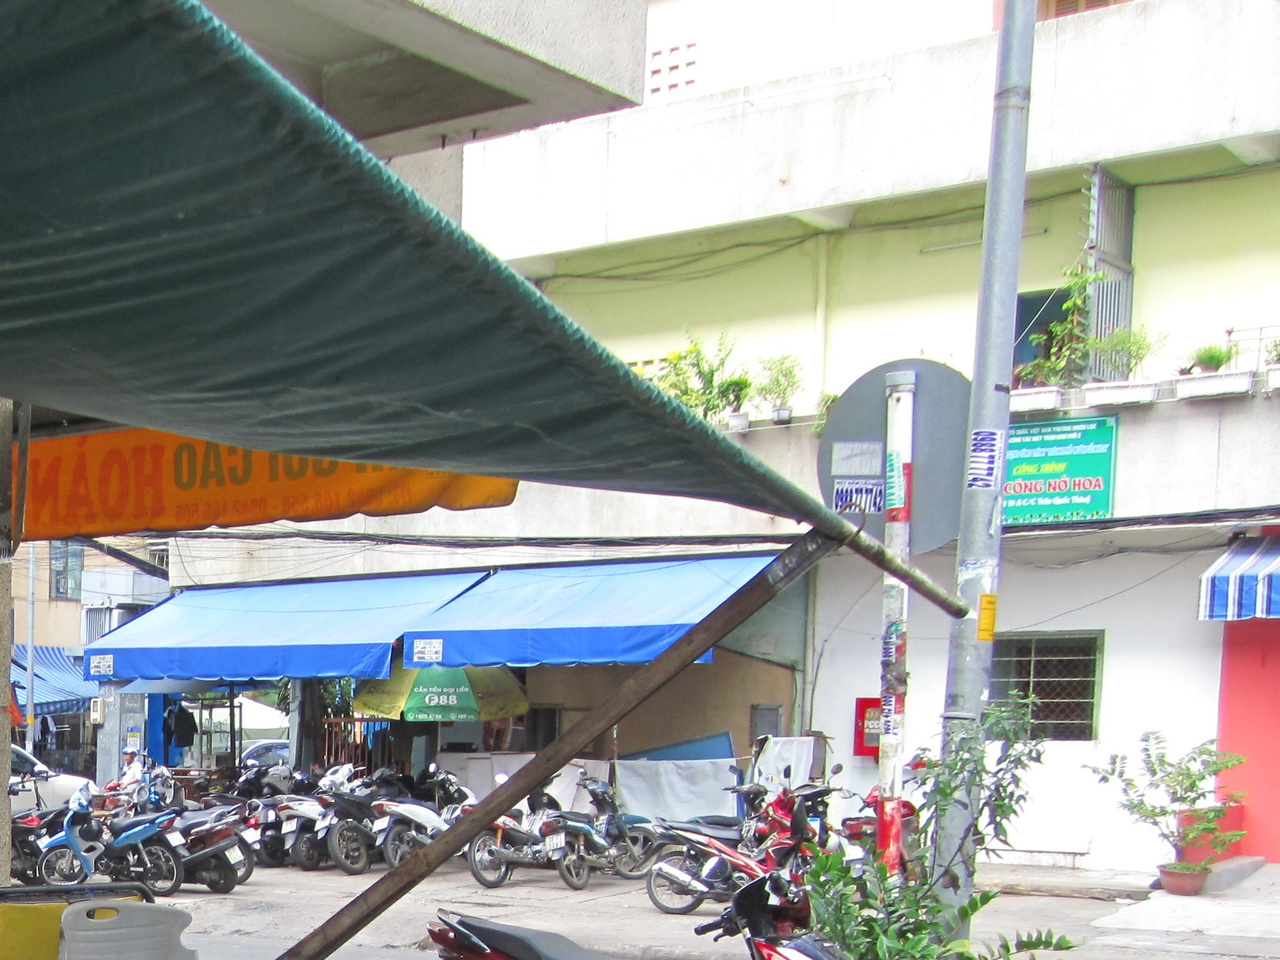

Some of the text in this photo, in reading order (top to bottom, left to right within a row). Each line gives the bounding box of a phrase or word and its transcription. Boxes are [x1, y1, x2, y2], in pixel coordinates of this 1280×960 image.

[1003, 475, 1103, 495] CÔNG NỞ HOA
[424, 693, 458, 706] F88
